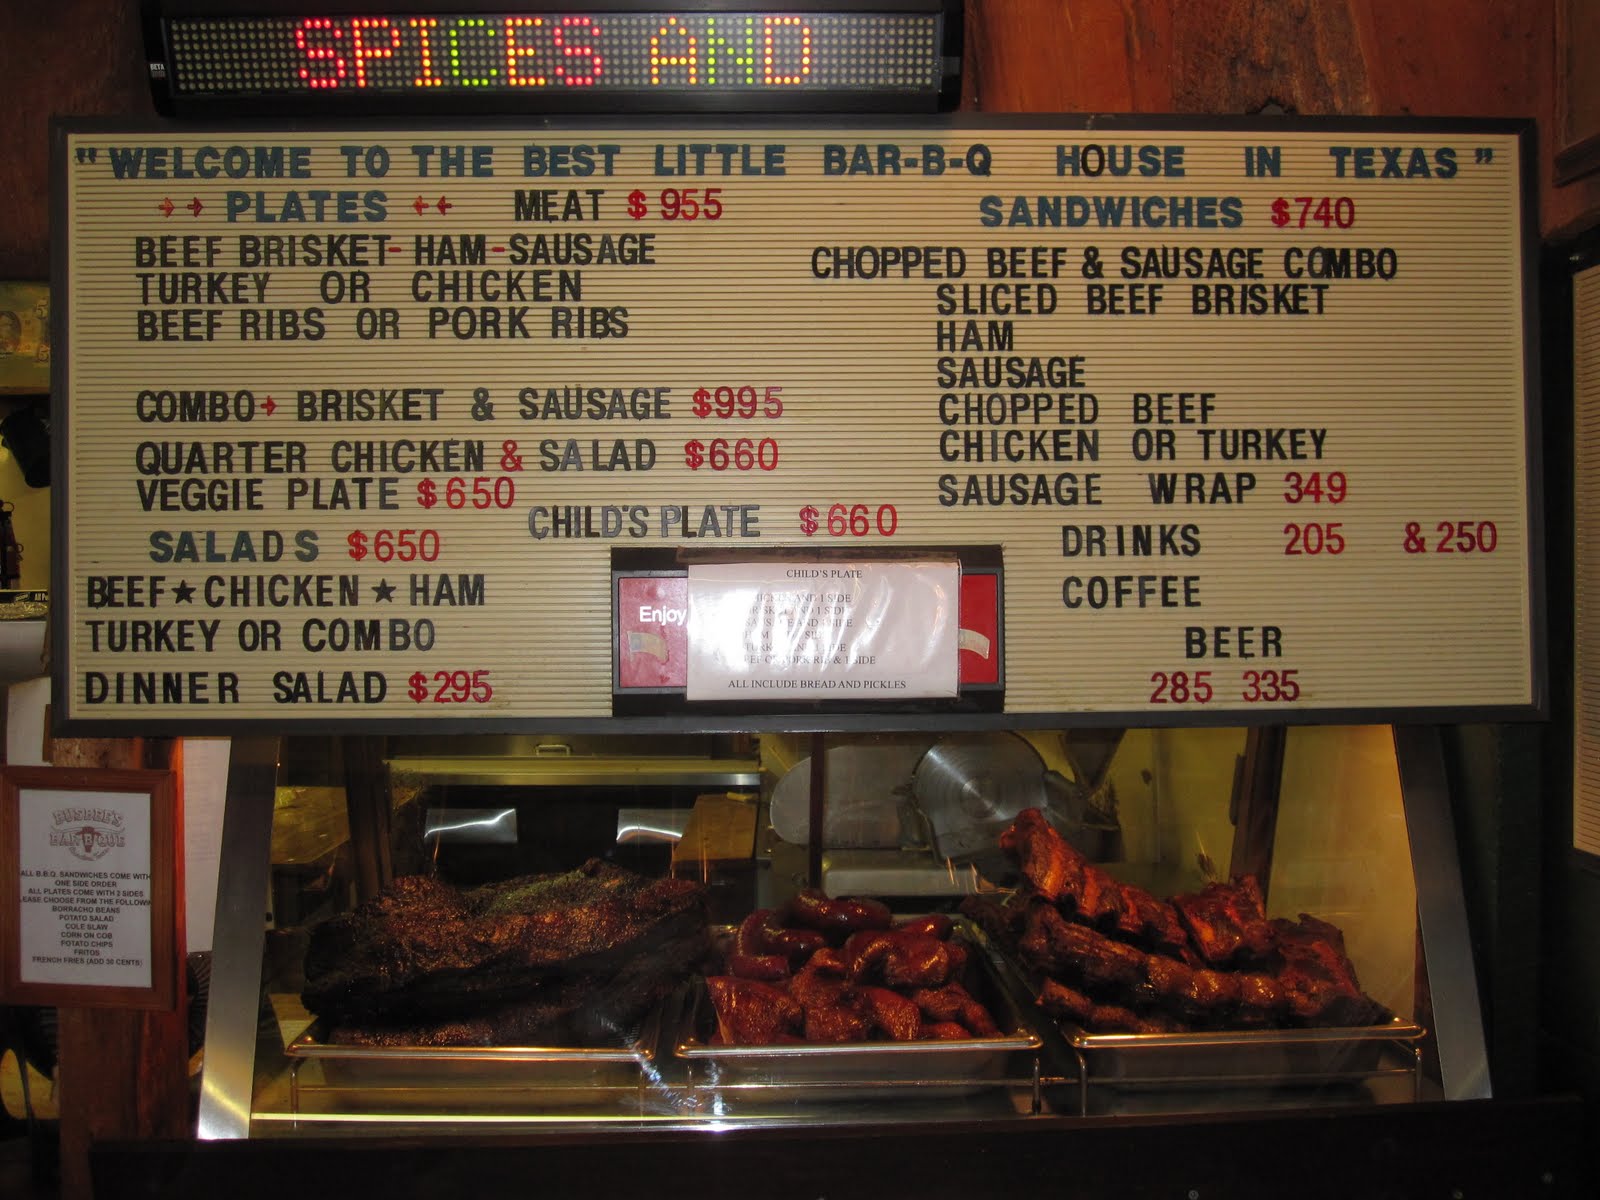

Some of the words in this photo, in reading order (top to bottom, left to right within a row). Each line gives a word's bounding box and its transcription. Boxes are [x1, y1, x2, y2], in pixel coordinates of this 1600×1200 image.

[294, 17, 602, 89] SPICES
[650, 17, 811, 86] AND
[341, 145, 391, 177] TO
[411, 145, 494, 177] THE
[523, 144, 621, 176] BEST
[654, 144, 787, 176] LITTLE
[823, 144, 992, 177] BAR-B-Q
[1056, 144, 1185, 178] HOUSE
[1245, 146, 1282, 178] IN
[226, 191, 389, 223] PLATES
[514, 190, 605, 222] MEAT
[980, 196, 1244, 229] SANDWICHES
[1270, 196, 1356, 229] $740
[136, 235, 223, 268] BEEF
[811, 246, 966, 279] CHOPPED
[987, 246, 1067, 279] BEEF
[1082, 247, 1104, 279] &
[1119, 246, 1264, 279] SAUSAGE
[1283, 247, 1398, 279] COMBO
[136, 272, 271, 306] TURKEY
[320, 271, 371, 304] OR
[411, 270, 583, 303] CHICKEN
[936, 284, 1057, 316] SLICED
[1086, 283, 1164, 315] BEEF
[1192, 284, 1330, 316] BRISKET
[137, 309, 223, 342] BEEF
[240, 307, 326, 341] RIBS
[355, 307, 401, 340] OR
[428, 307, 531, 340] PORK
[550, 306, 630, 339] RIBS
[936, 321, 1015, 353] HAM
[937, 356, 1086, 389] SAUSAGE
[136, 390, 256, 422] COMBO
[299, 389, 444, 422] BRISKET
[471, 389, 495, 421] &
[519, 387, 672, 420] SAUSAGE
[691, 386, 784, 419] $995
[938, 393, 1099, 426] CHOPPED
[1132, 392, 1216, 424] BEEF
[136, 441, 307, 477] QUARTER
[331, 440, 484, 474] CHICKEN
[499, 440, 524, 473] &
[539, 439, 657, 472] SALAD
[684, 438, 780, 472] $660
[938, 429, 1100, 463] CHICKEN
[1132, 428, 1177, 462] OR
[1197, 428, 1328, 461] TURKEY
[136, 478, 264, 512] VEGGIE
[287, 478, 400, 511] PLATE
[416, 476, 515, 510] $650
[937, 473, 1103, 506] SAUSAGE
[1148, 472, 1256, 505] WRAP
[1283, 471, 1348, 505] 349
[528, 505, 649, 540] CHILD'S
[660, 505, 761, 538] PLATE
[149, 530, 320, 563] SALADS
[347, 529, 441, 563] $650
[1061, 524, 1201, 558] DRINKS
[1283, 523, 1346, 556] 205
[786, 569, 829, 579] CHILD'S
[831, 569, 864, 579] PLATE
[87, 575, 167, 609] BEEF
[203, 574, 360, 608] CHICKEN
[410, 573, 486, 607] HAM
[1061, 576, 1202, 609] COFFEE
[639, 606, 687, 628] Enjoy
[86, 620, 219, 653] TURKEY
[238, 620, 283, 653] OR
[302, 619, 436, 653] COMBO
[1185, 627, 1283, 660] BEER
[86, 672, 240, 705] DINNER
[273, 670, 388, 704] SALAD
[407, 669, 493, 703] $295
[728, 680, 750, 690] ALL
[751, 680, 799, 690] INCLUDE
[800, 680, 836, 690] BREAD
[837, 680, 861, 690] AND
[863, 679, 907, 689] PICKLES
[1150, 671, 1214, 704] 285
[1241, 670, 1300, 703] 335
[54, 879, 70, 887] ONE
[72, 880, 89, 888] SIDE
[91, 880, 117, 888] ORDER
[59, 871, 108, 879] SANDWICHES
[43, 888, 72, 896] PLATES
[73, 889, 94, 897] COME
[96, 889, 115, 897] WITH
[122, 890, 144, 898] SIDES
[51, 905, 94, 913] BORRACHO
[95, 906, 120, 914] BEANS
[59, 914, 87, 922] POTATO
[86, 923, 108, 931] SLAW
[91, 940, 113, 948] CHIPS
[96, 932, 113, 940] COB
[32, 956, 62, 964] FRENCH
[63, 957, 85, 965] FRIES
